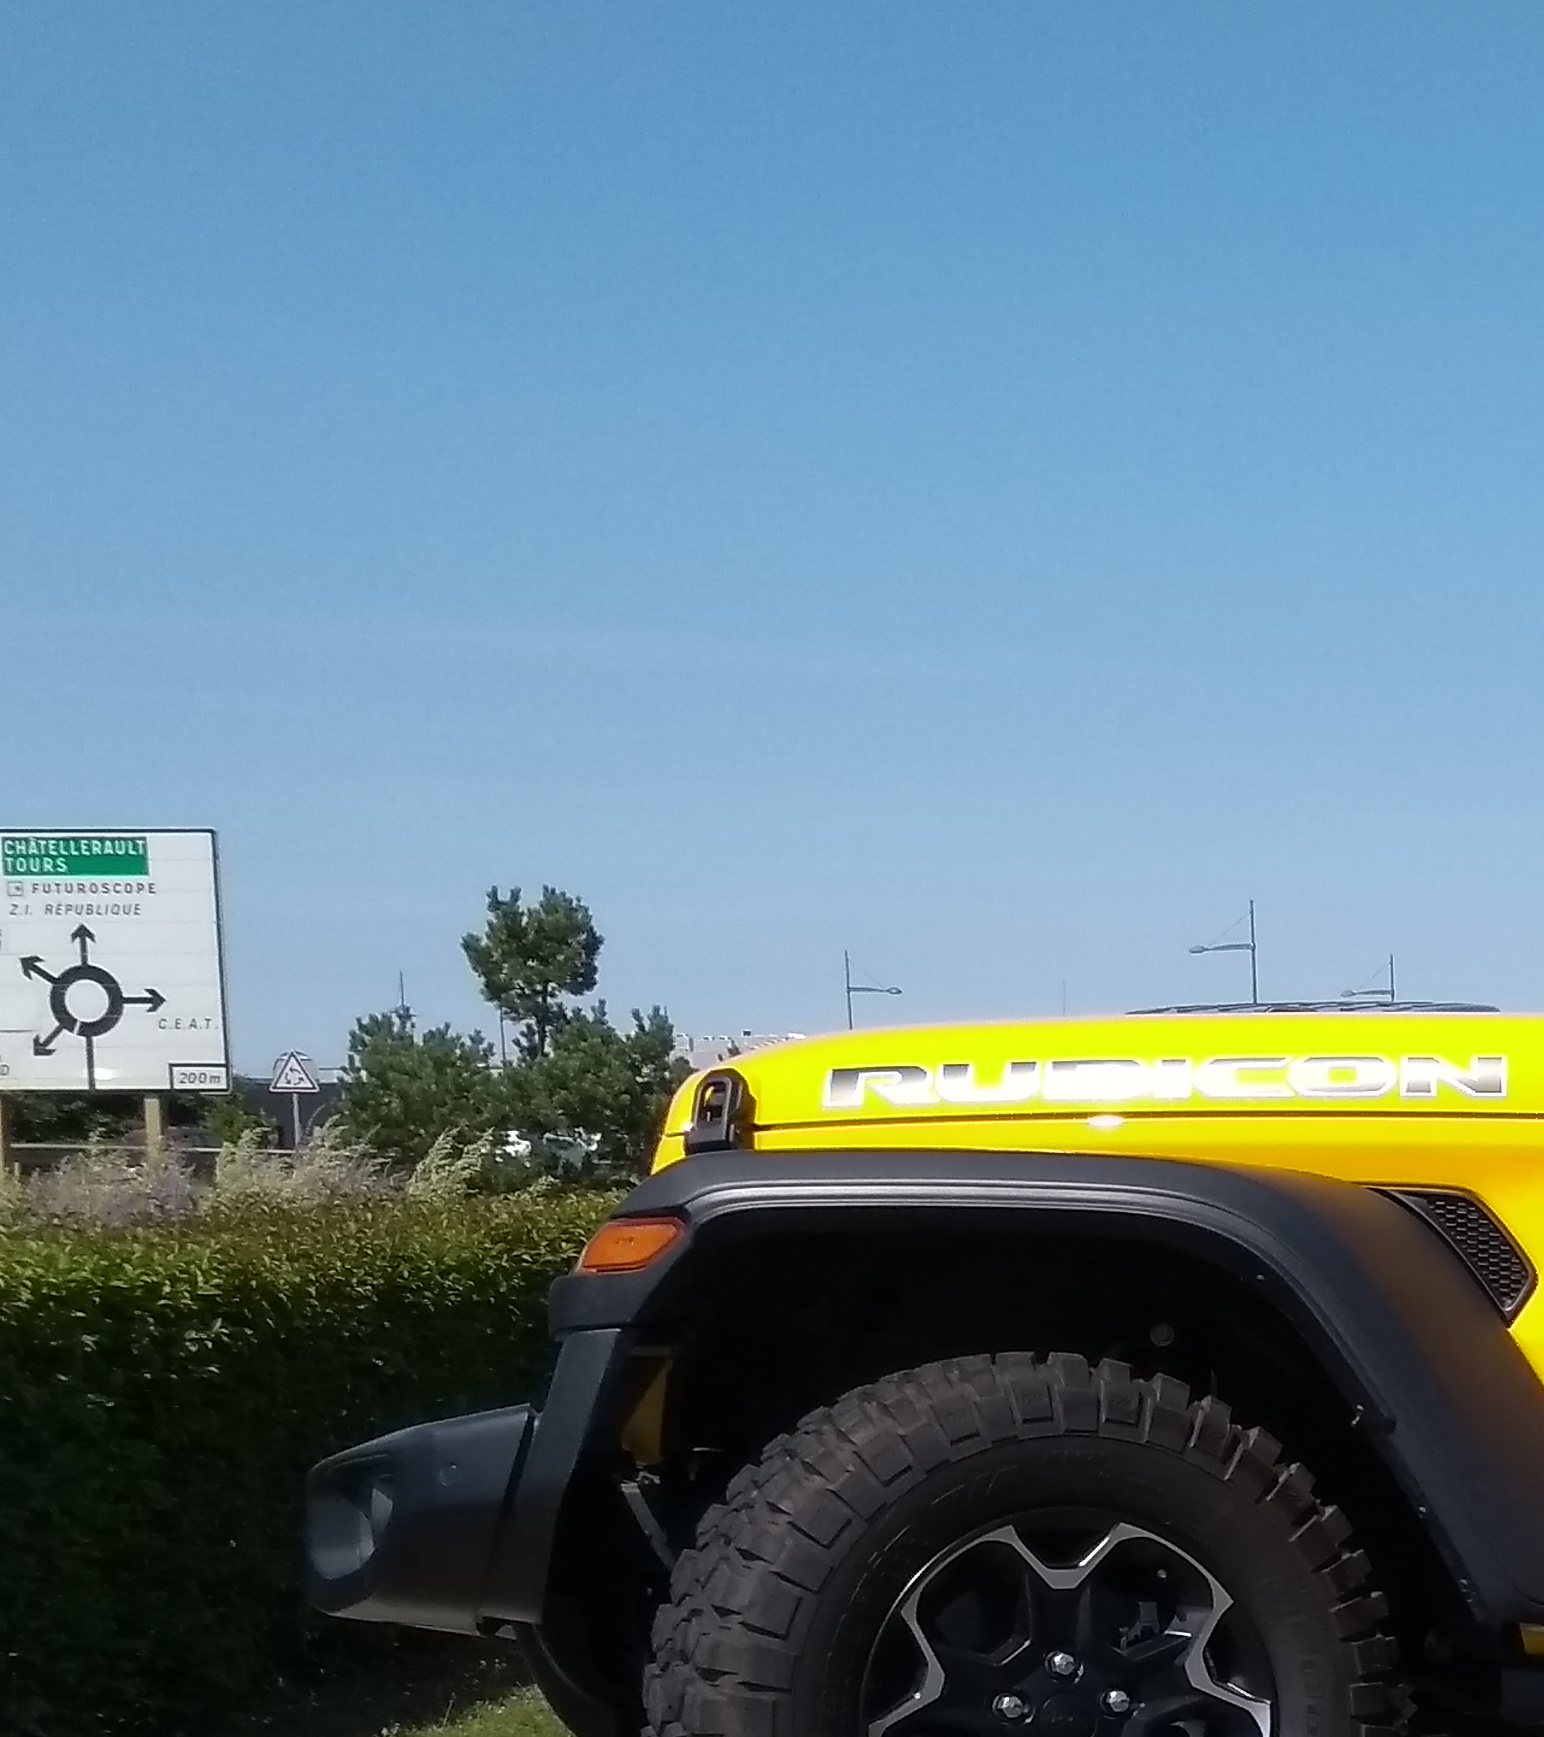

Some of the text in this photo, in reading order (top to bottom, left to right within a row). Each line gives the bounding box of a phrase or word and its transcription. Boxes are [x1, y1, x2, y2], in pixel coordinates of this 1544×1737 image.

[3, 837, 146, 856] CHÂTELLERAULT
[4, 857, 68, 873] TOURS
[31, 882, 156, 895] FUTUROSCOPE
[158, 1018, 219, 1031] C.E.A.T.
[821, 1054, 1509, 1108] RUBICON
